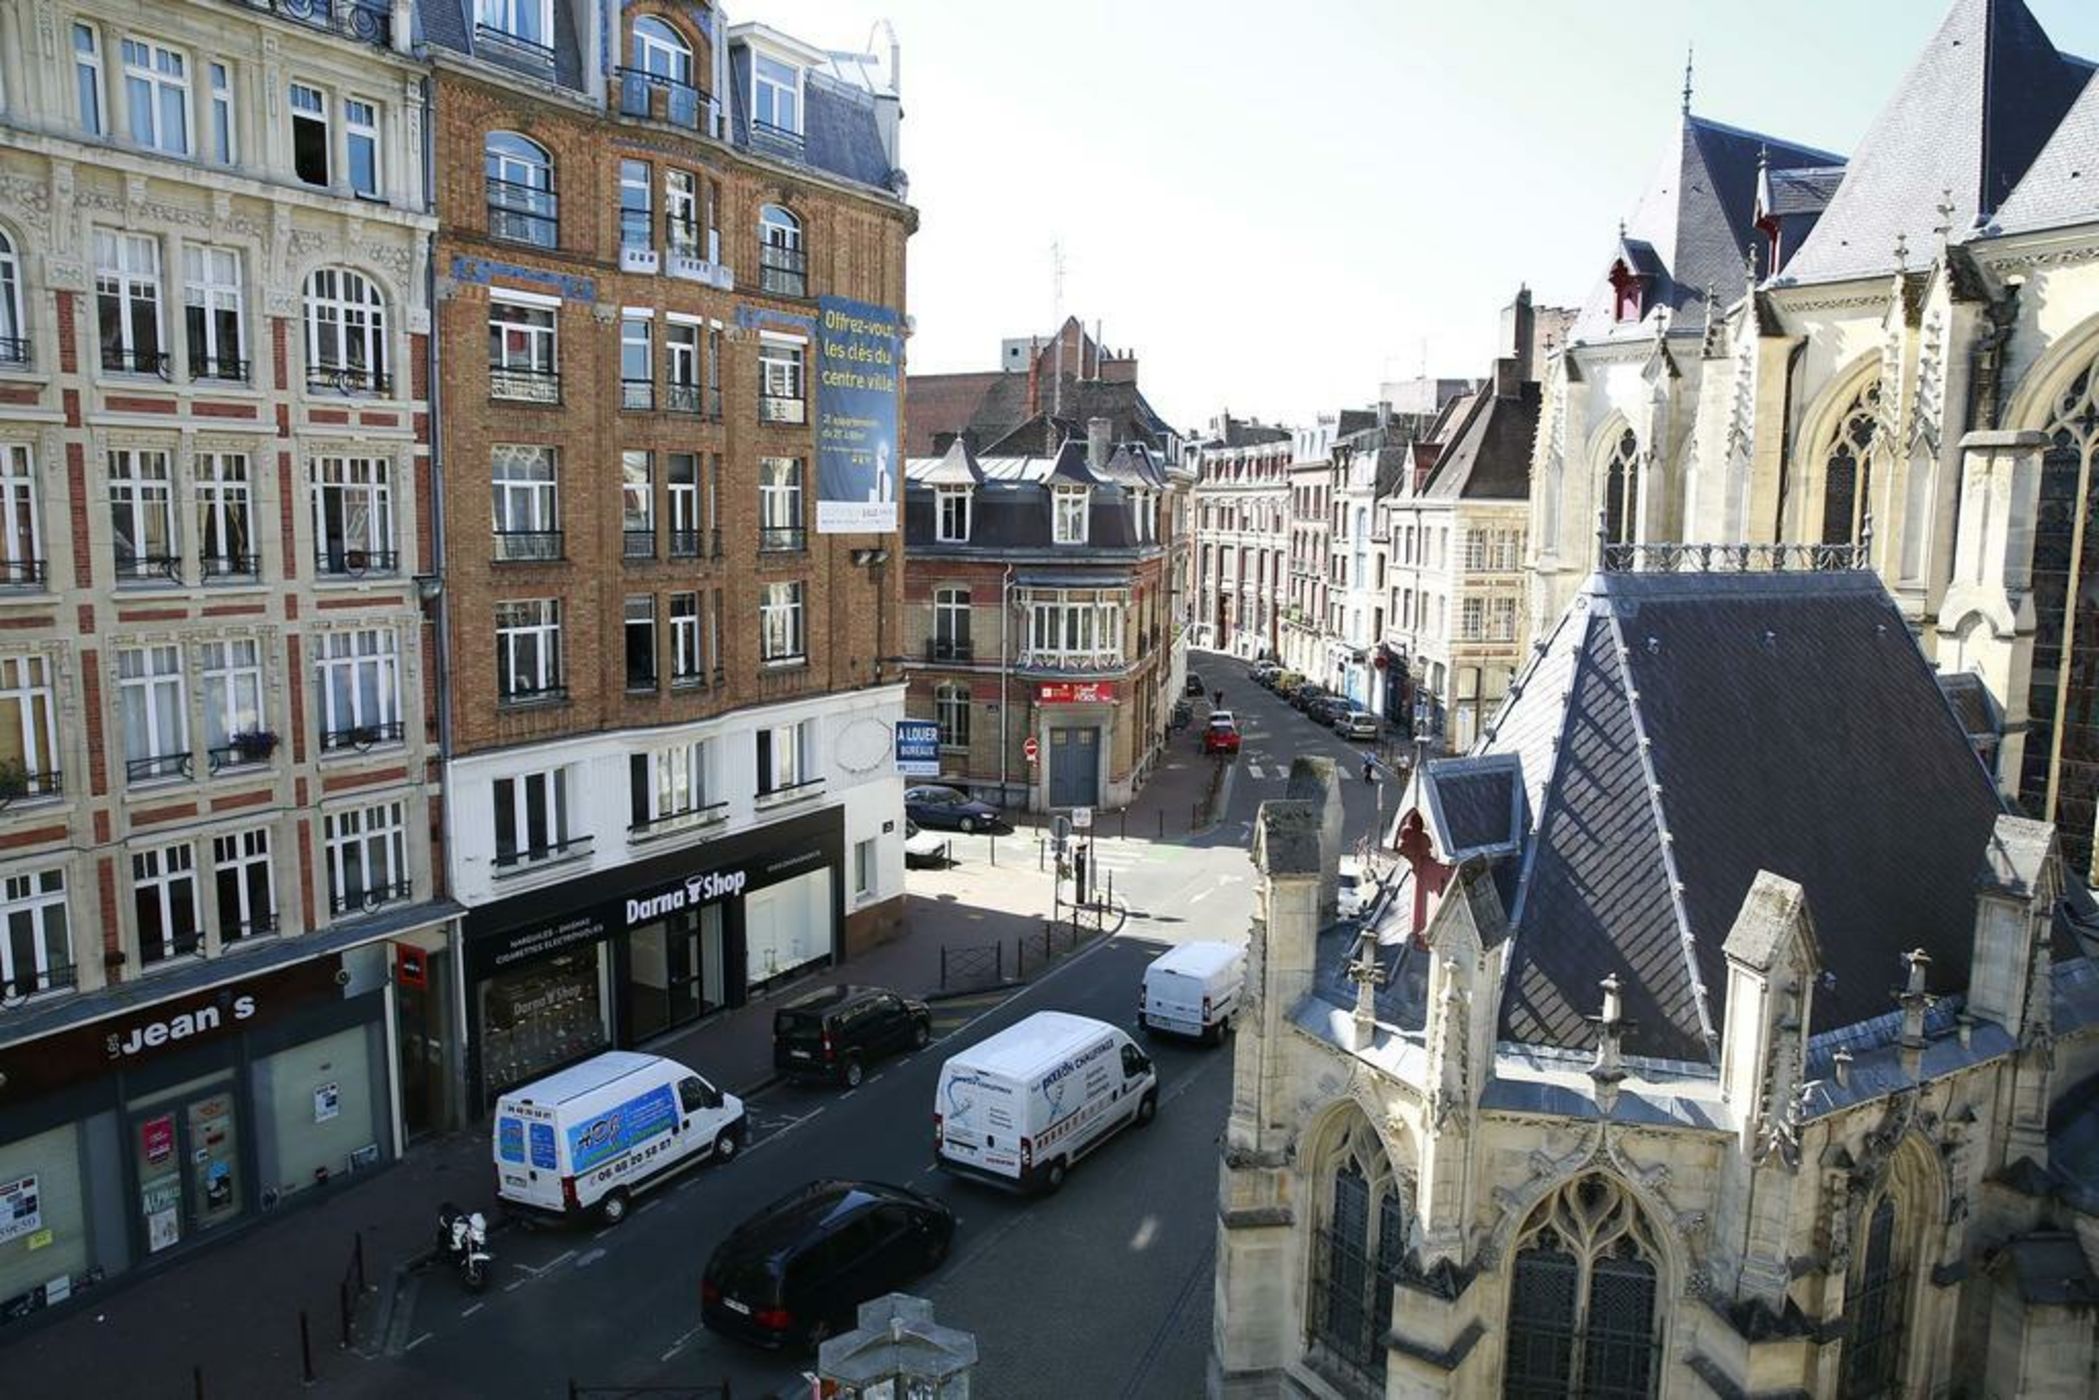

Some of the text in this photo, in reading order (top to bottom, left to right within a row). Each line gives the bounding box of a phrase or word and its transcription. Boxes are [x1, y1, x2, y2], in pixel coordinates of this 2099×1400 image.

[824, 338, 892, 365] les clés du
[867, 372, 894, 392] ville
[906, 727, 938, 741] LOUER
[626, 870, 746, 925] Darna Shop
